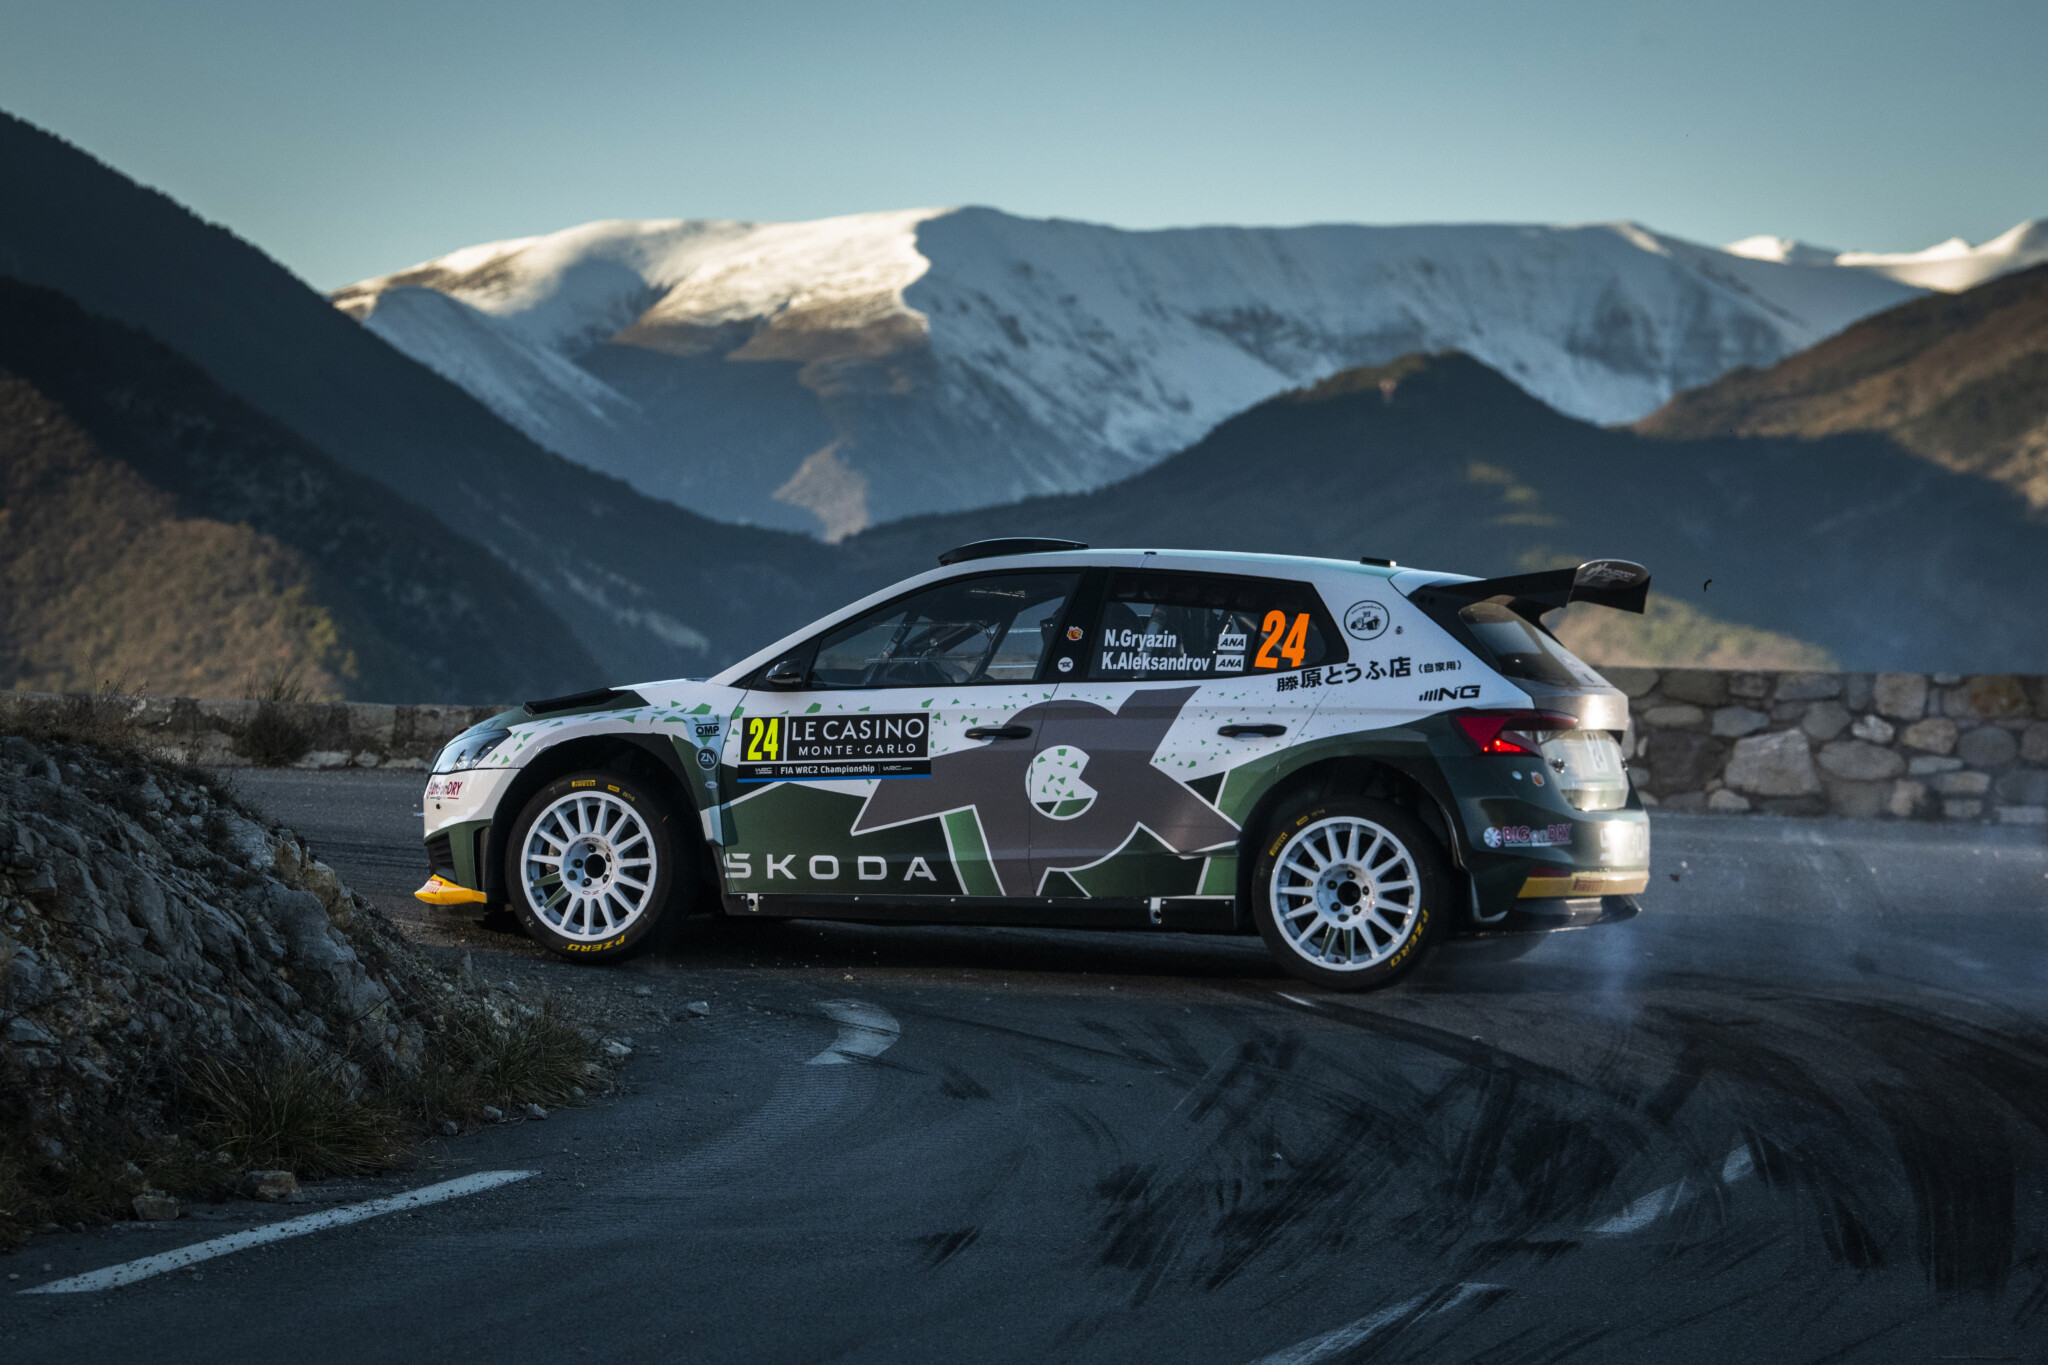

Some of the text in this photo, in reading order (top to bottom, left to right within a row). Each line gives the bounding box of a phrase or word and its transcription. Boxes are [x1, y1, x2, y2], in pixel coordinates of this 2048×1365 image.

[1104, 628, 1177, 652] N.Gryazin
[1221, 637, 1244, 648] ANA
[1254, 609, 1310, 669] 24
[1101, 651, 1211, 672] K.Aleksandrov
[1218, 658, 1242, 668] ANA
[695, 725, 720, 736] OMP
[791, 718, 925, 742] LE CASINO
[747, 717, 779, 761] 24
[798, 743, 916, 756] MONTE CARLO
[700, 752, 715, 764] ZN
[780, 765, 875, 776] FIA WRC2 Championship
